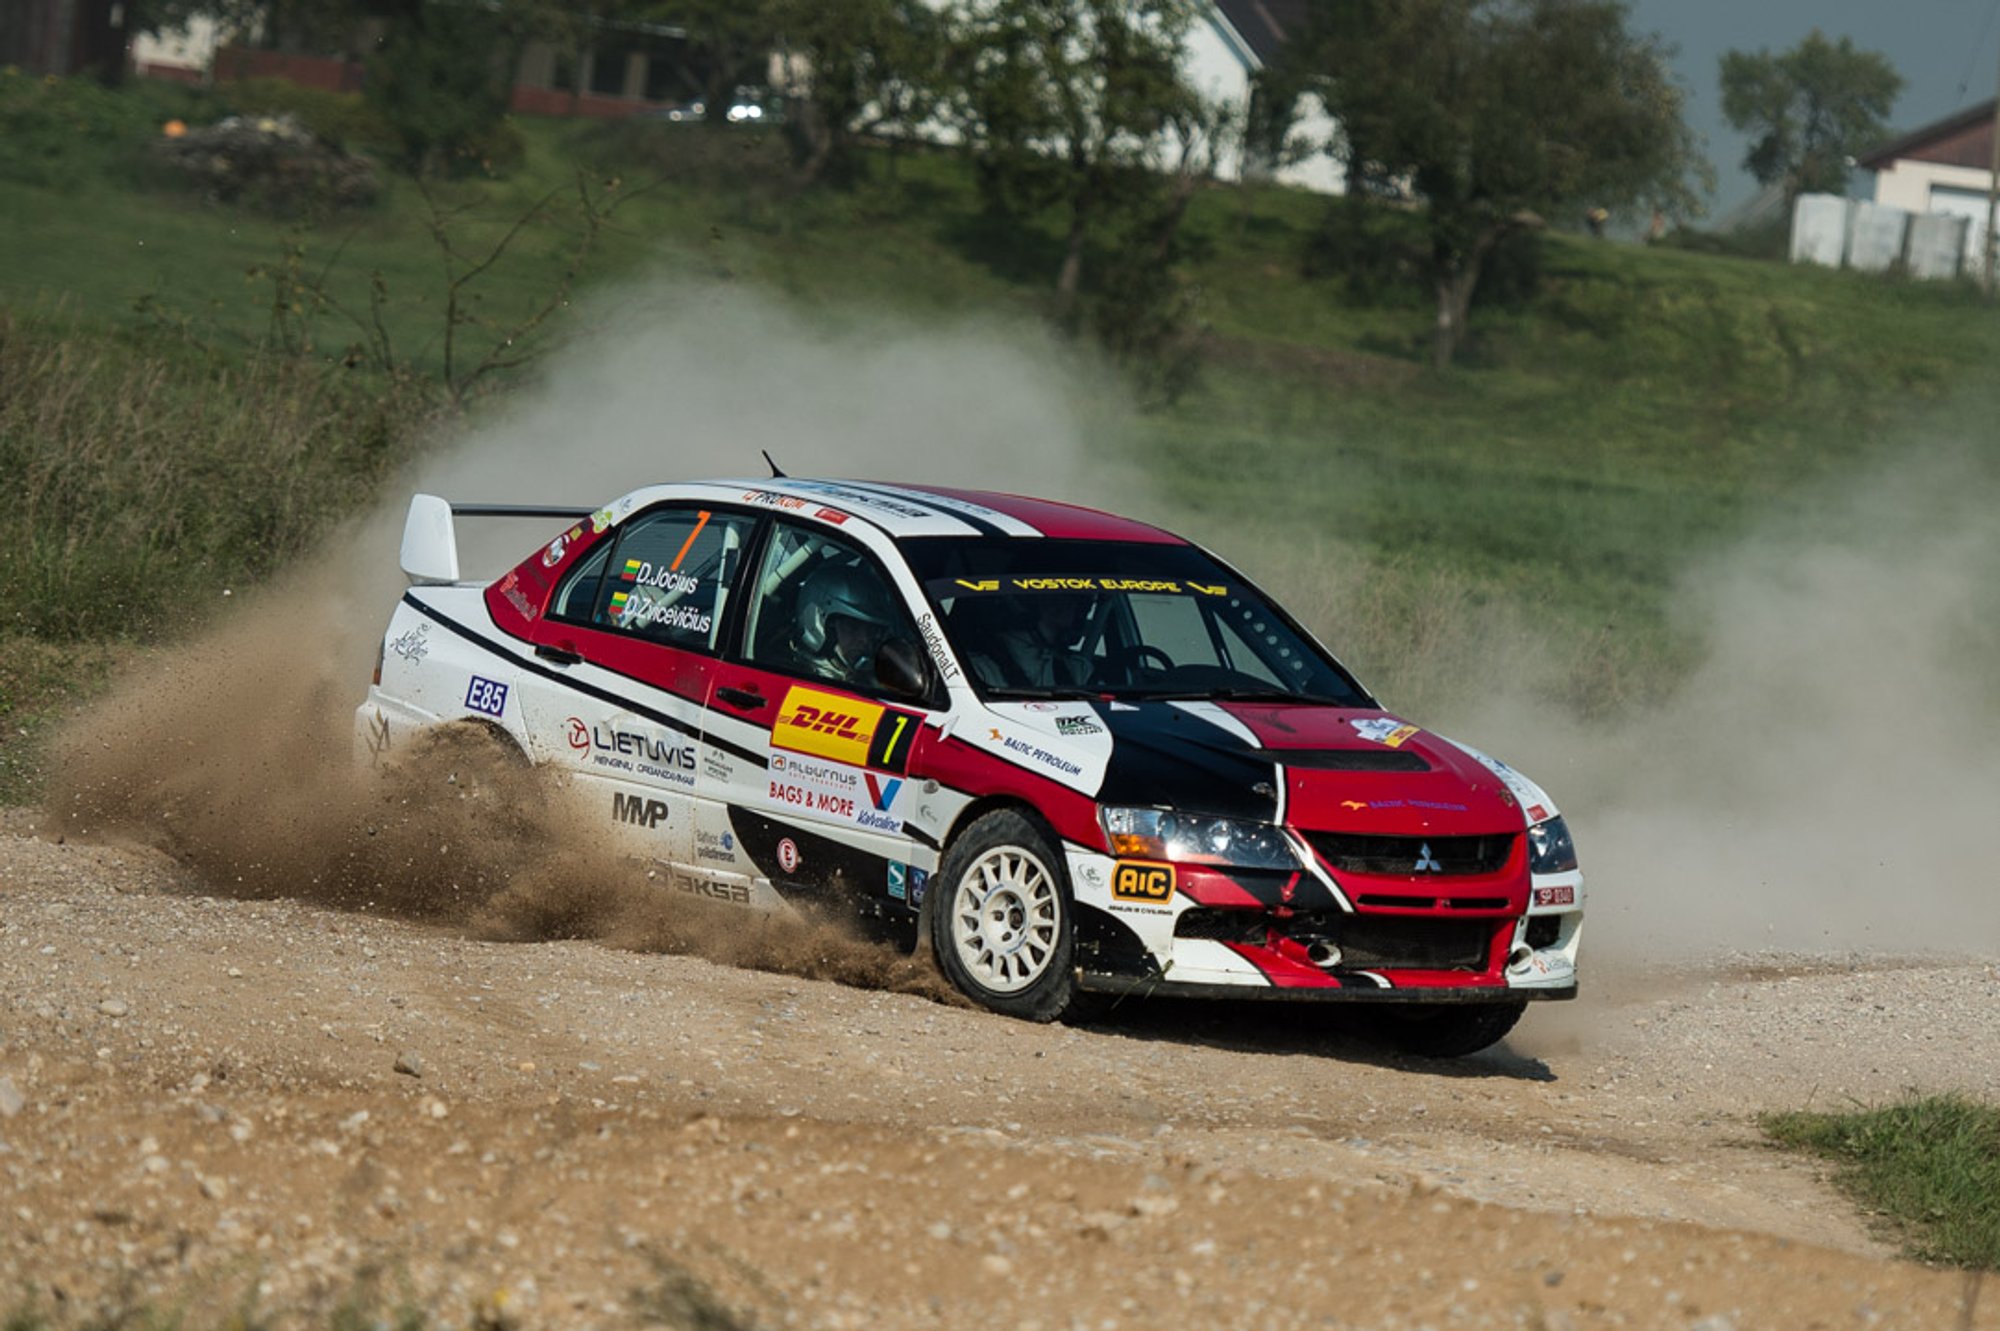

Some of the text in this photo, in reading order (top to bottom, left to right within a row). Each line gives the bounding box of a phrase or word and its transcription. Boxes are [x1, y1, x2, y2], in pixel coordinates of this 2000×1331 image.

[1012, 578, 1182, 592] VOSTOK EUROPE
[467, 679, 504, 713] E85
[790, 704, 859, 739] DHL
[594, 726, 696, 770] LIETUVIS
[1004, 736, 1082, 776] BALTIC PETROLEUM
[769, 781, 803, 804] BAGS
[806, 791, 814, 807] &
[817, 793, 854, 817] MORE
